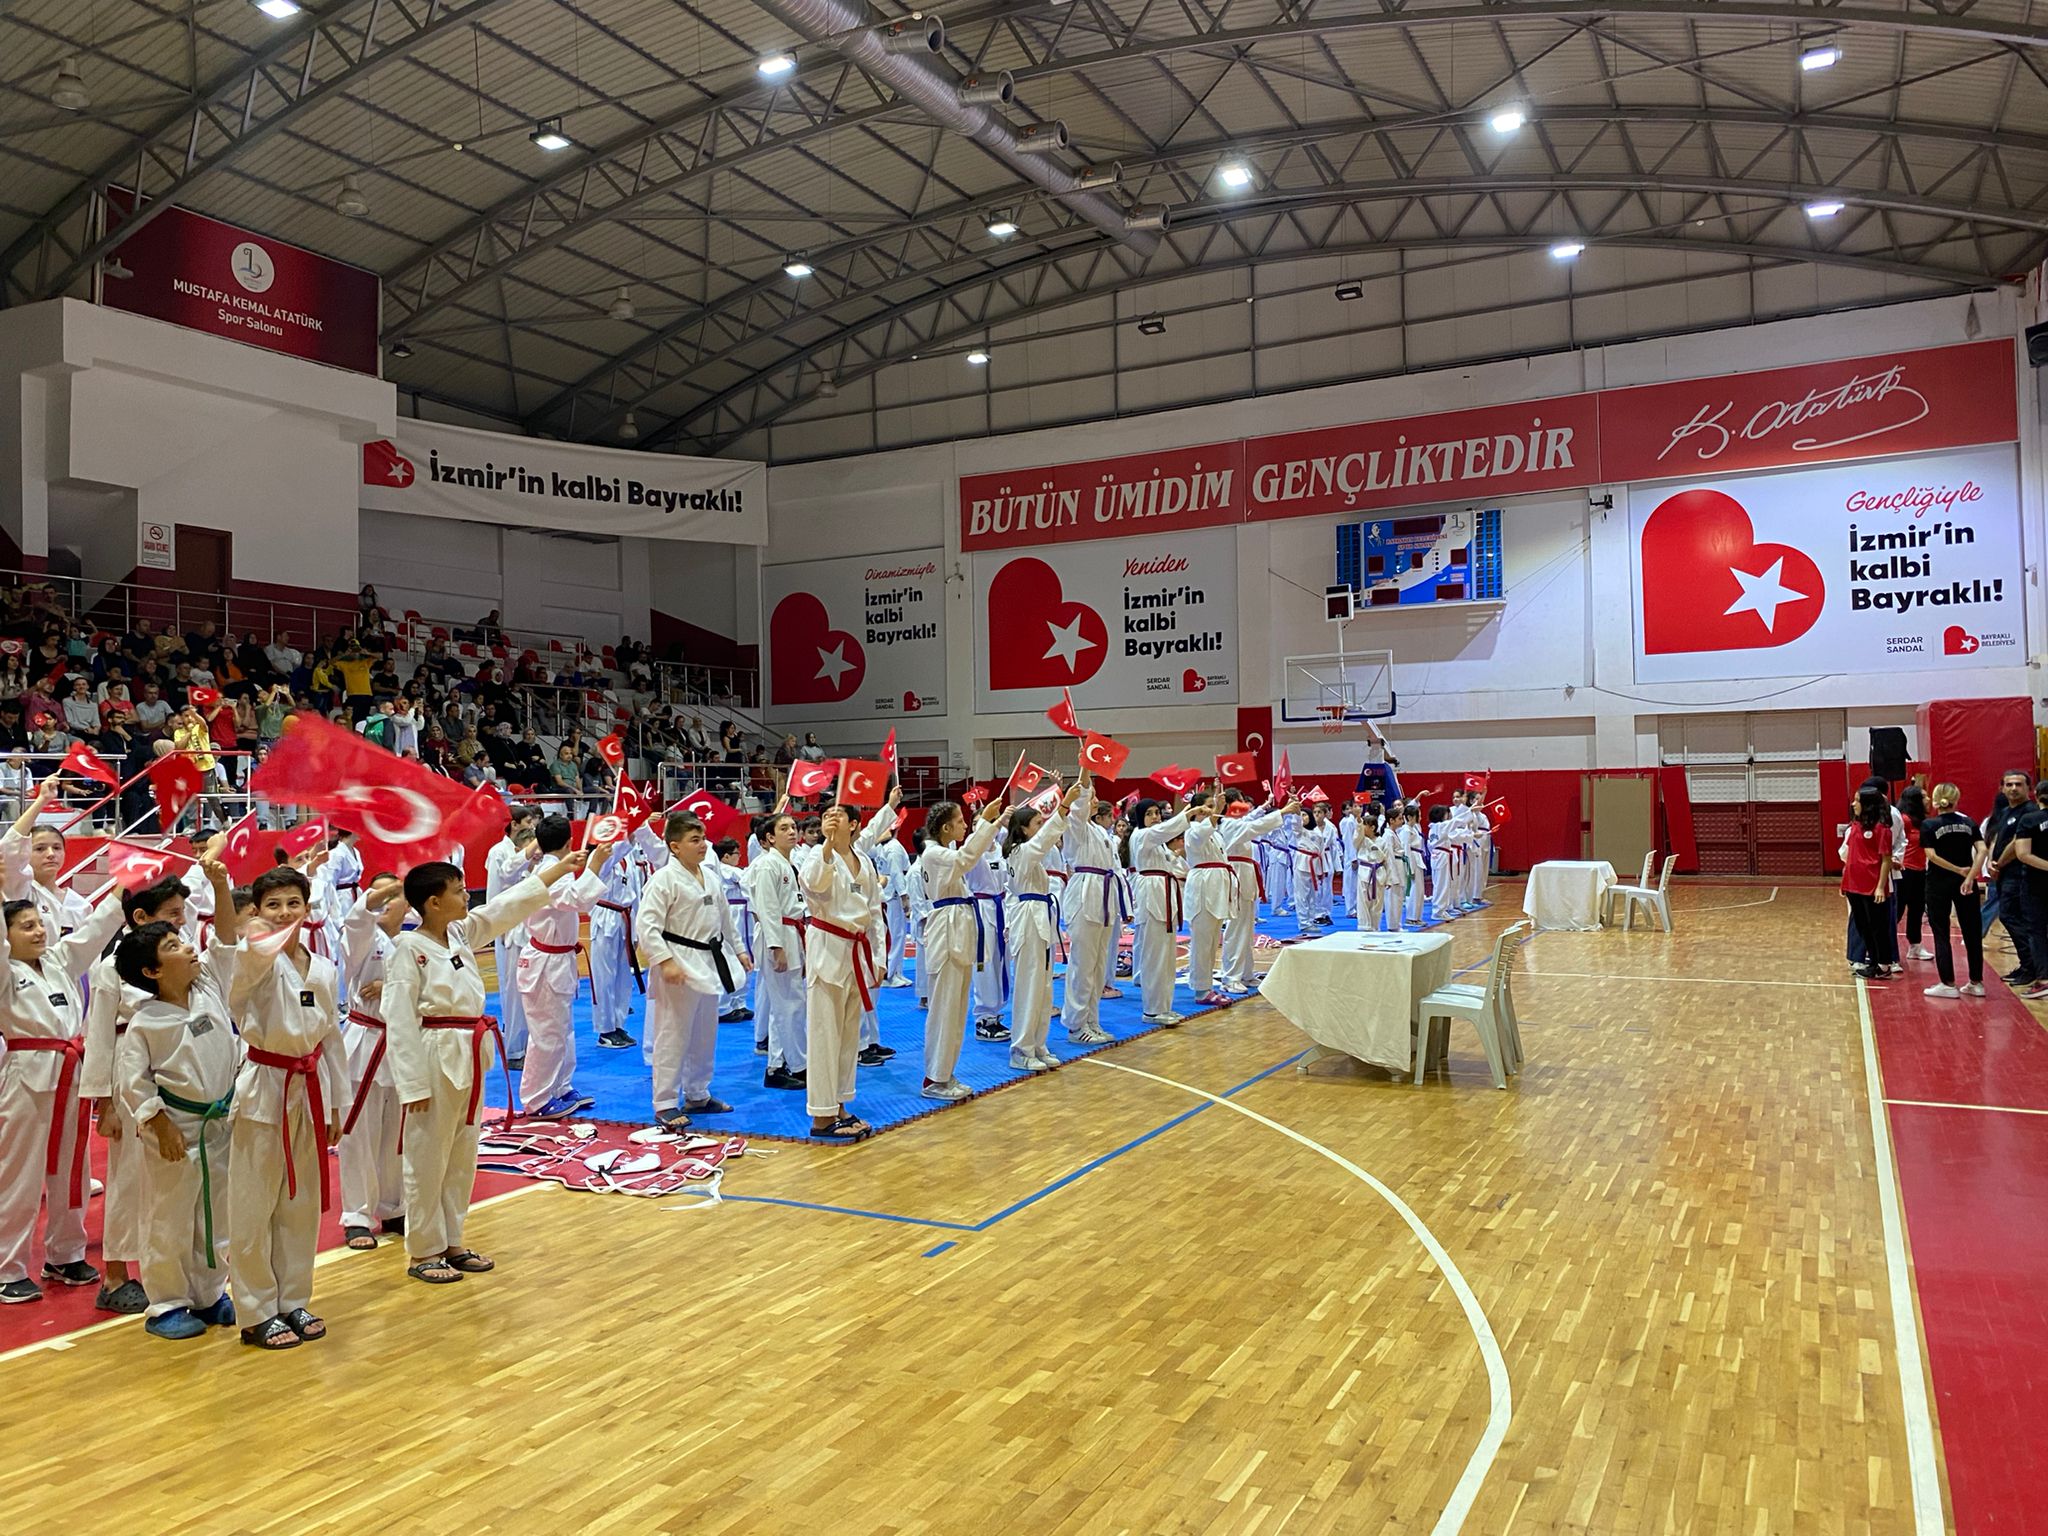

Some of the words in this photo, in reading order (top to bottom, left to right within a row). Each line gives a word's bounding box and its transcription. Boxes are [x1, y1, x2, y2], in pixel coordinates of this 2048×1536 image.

[173, 278, 230, 306] MUSTAFA
[232, 295, 272, 317] KEMAL
[273, 308, 323, 332] ATATÜRK
[218, 308, 244, 325] Spor
[246, 316, 283, 336] Salonu
[968, 480, 1081, 536] BÜTÜN
[1093, 461, 1234, 523] ÜMİDİM
[1251, 417, 1575, 505] GENÇLİKTEDİR
[551, 471, 621, 503] kalbi
[627, 479, 743, 514] Bayraklı!
[1846, 481, 1985, 519] Gençliğiyle
[864, 563, 937, 581] Dinamizmiyle
[1122, 554, 1190, 578] Yeniden
[1850, 553, 1931, 582] kalbi
[1851, 578, 2004, 614] Bayraklı!
[866, 607, 903, 625] kalbi
[1124, 611, 1176, 633] kalbi
[866, 623, 937, 645] Bayraklı!
[1125, 632, 1222, 659] Bayraklı!
[1886, 636, 1924, 646] SERDAR
[1886, 645, 1925, 654] SANDAL
[1146, 677, 1171, 685] SERDAR
